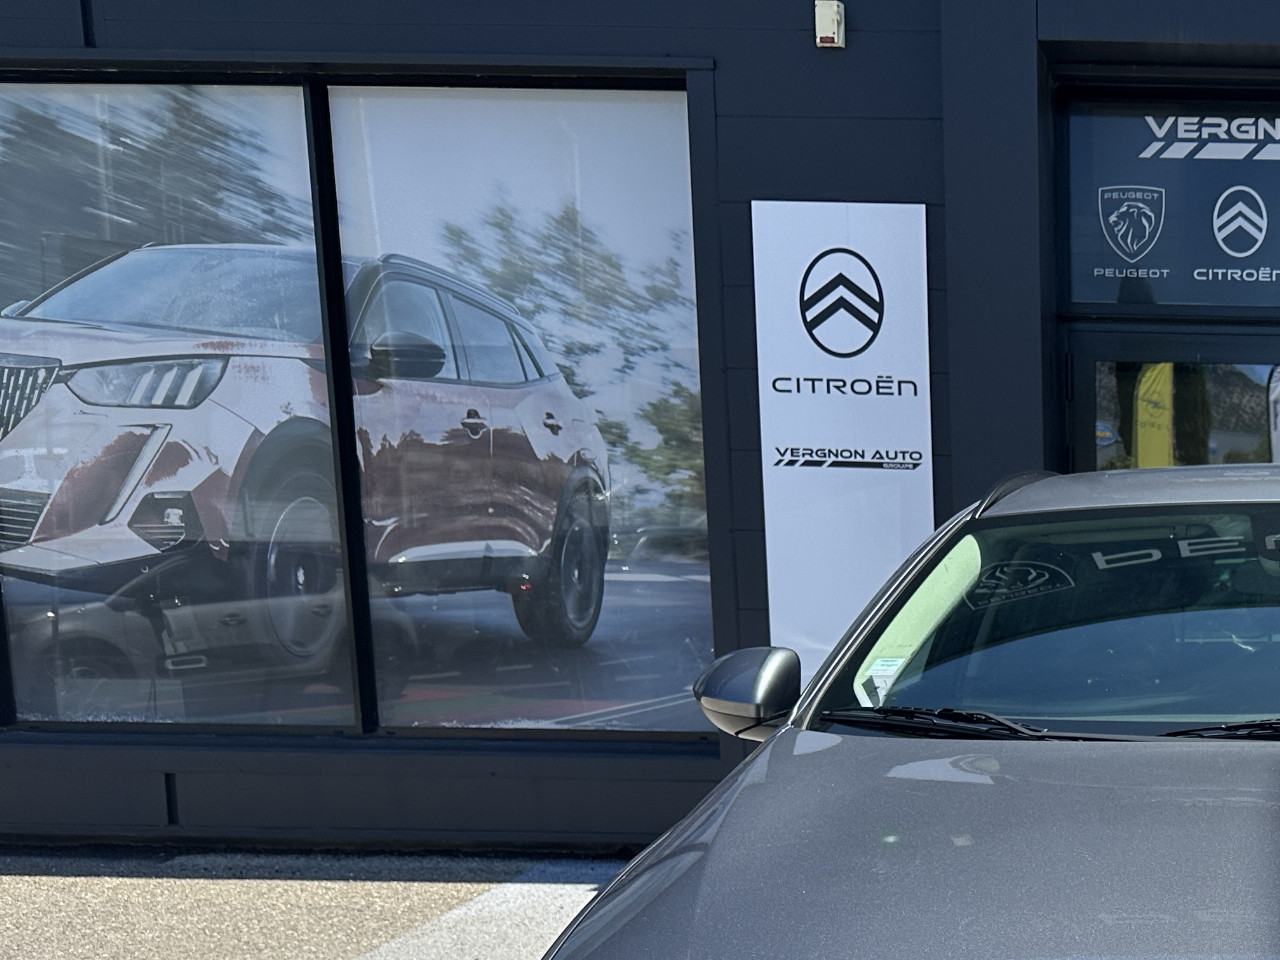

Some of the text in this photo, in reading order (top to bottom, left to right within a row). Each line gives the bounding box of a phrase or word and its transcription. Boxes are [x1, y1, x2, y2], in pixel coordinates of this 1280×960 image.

[1104, 191, 1159, 201] PEUGEOT
[1093, 268, 1171, 278] PEUGEOT
[775, 447, 923, 461] VERGNON AUTO
